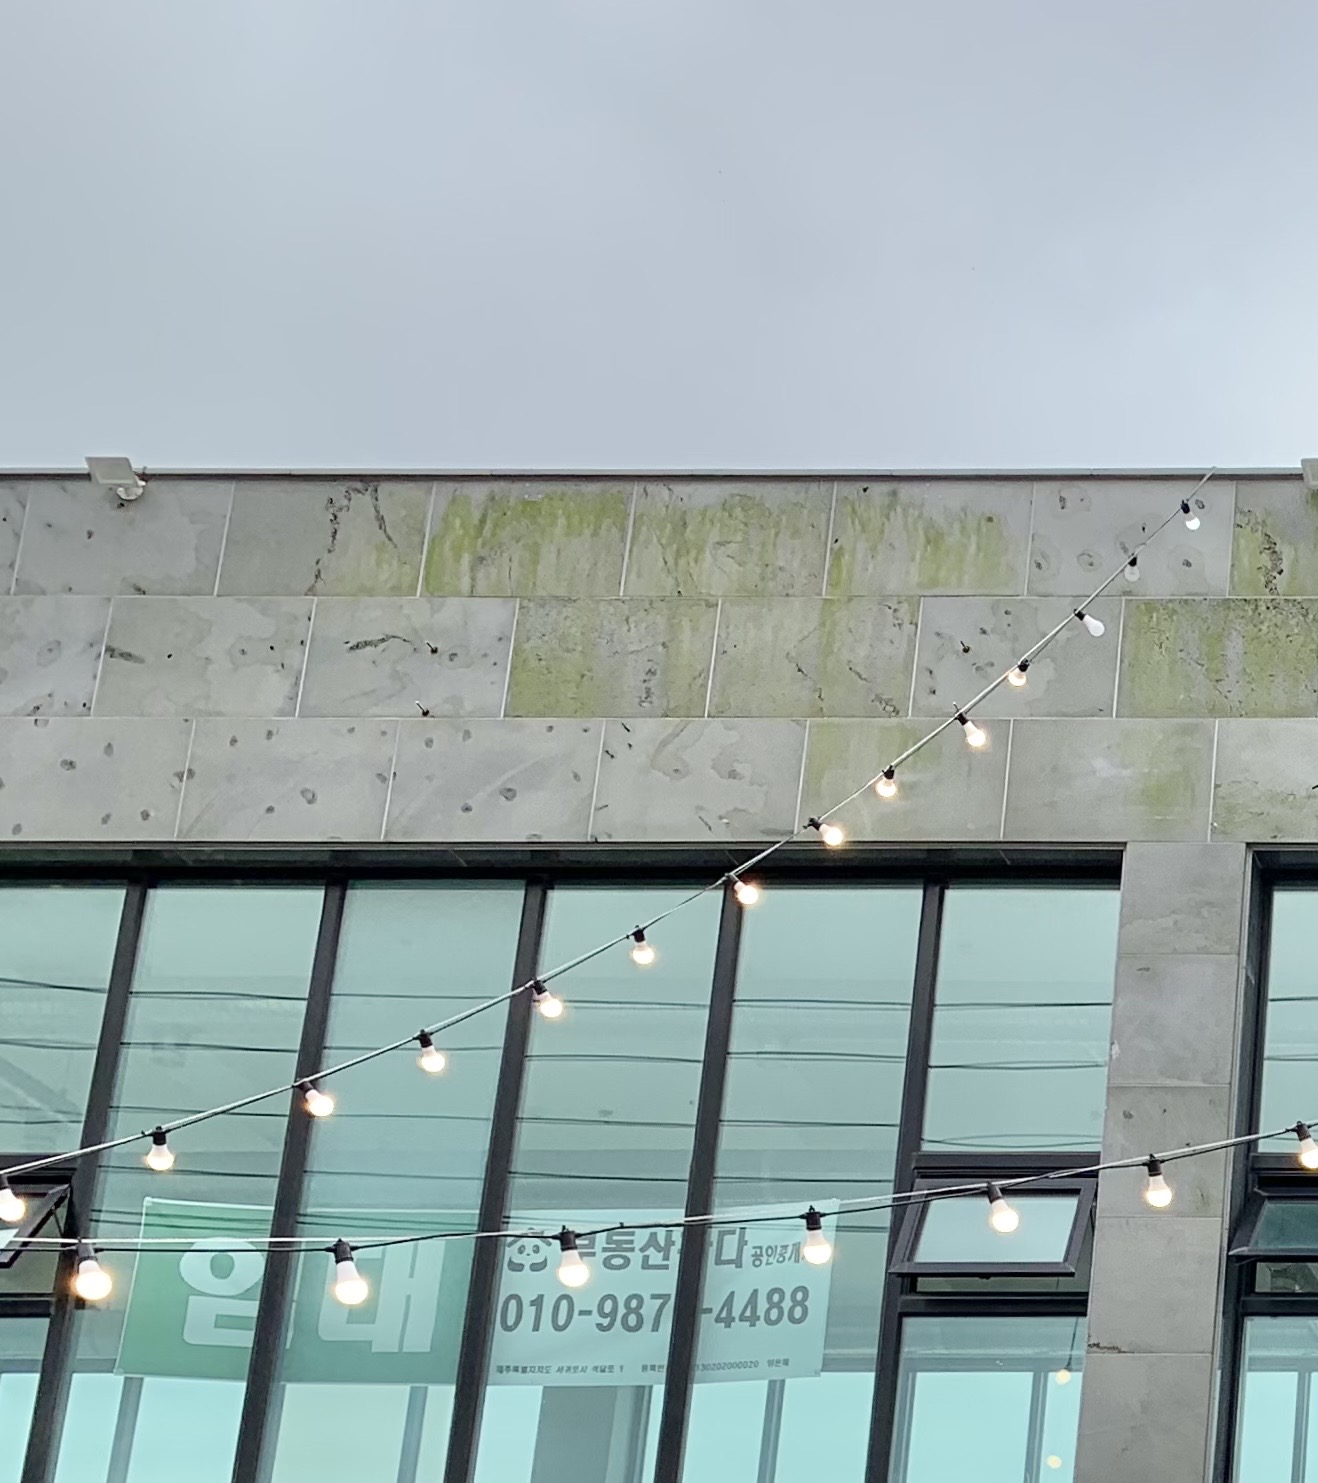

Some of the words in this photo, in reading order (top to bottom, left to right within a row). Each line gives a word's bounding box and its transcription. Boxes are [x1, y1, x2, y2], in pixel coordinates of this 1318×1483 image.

[573, 1227, 748, 1270] 동산다
[751, 1241, 808, 1268] 공인중개
[500, 1285, 809, 1333] 010-987-4488
